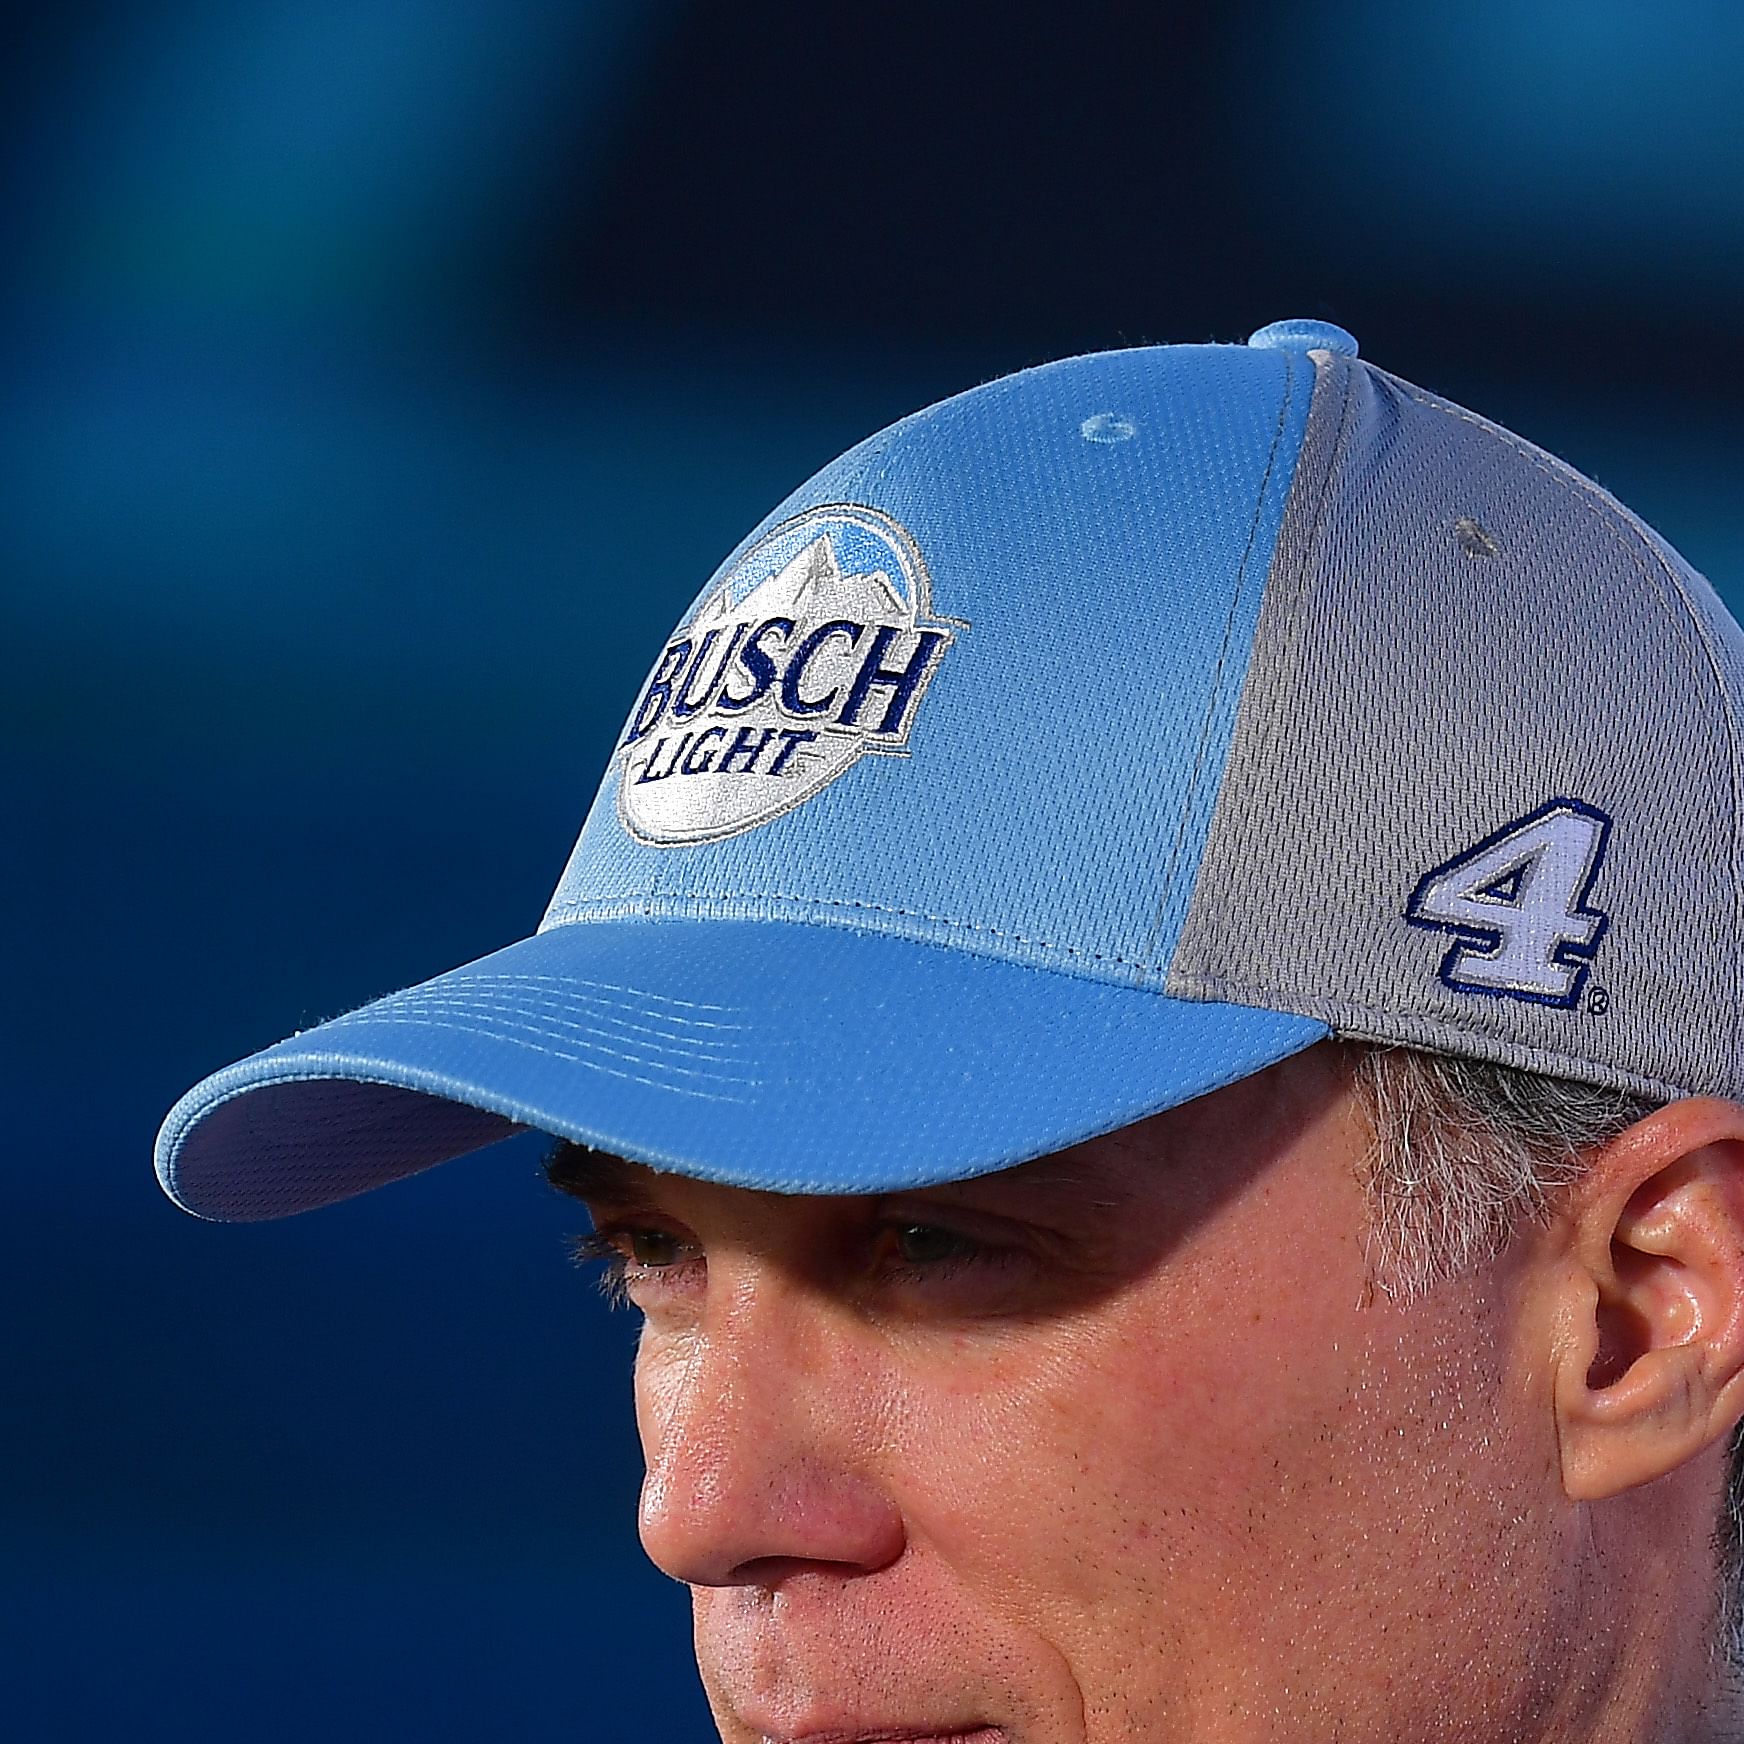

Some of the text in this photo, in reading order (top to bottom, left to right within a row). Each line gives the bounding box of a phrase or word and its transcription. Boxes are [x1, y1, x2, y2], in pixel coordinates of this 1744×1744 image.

[622, 616, 951, 746] BUSCH
[633, 725, 821, 785] LIGHT
[1403, 796, 1614, 1011] 4
